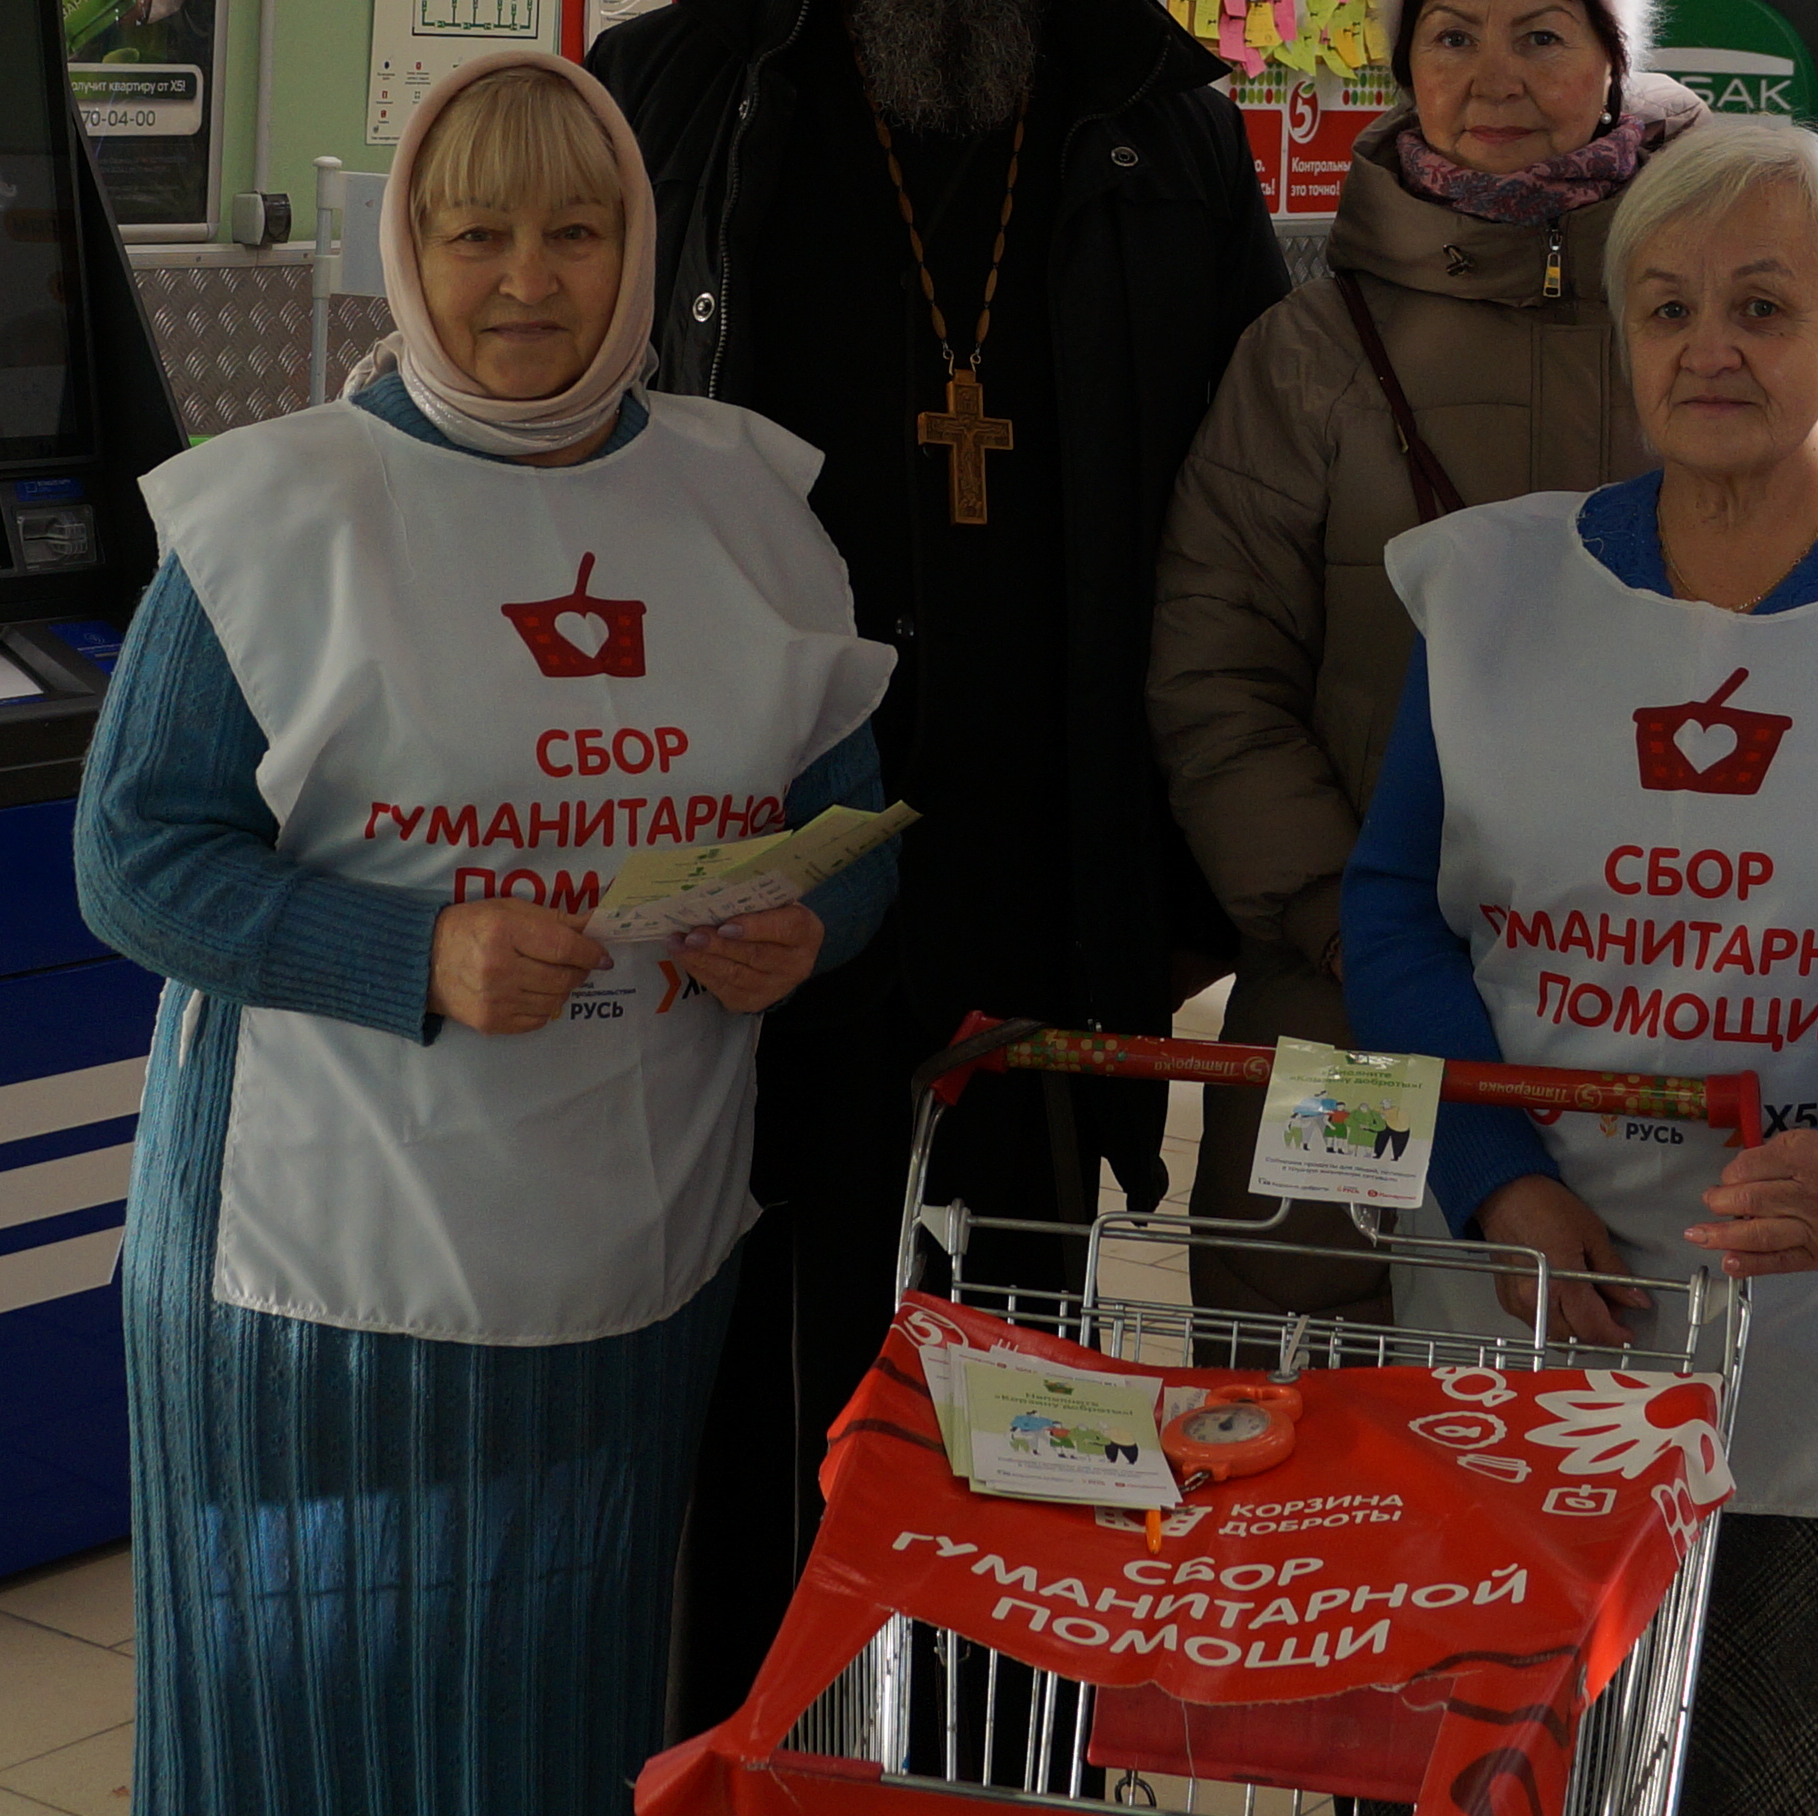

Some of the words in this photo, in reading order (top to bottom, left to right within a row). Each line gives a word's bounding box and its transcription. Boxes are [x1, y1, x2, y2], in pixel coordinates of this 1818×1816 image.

[71, 81, 107, 94] олучит
[109, 82, 156, 95] квартиру
[1680, 75, 1792, 110] БАК
[81, 110, 156, 126] 70-04-00
[1291, 157, 1352, 176] Контрольны
[1291, 184, 1307, 196] это
[1308, 180, 1340, 196] точно!
[536, 726, 689, 778] СБОР
[1604, 845, 1774, 902] СБОР
[570, 1001, 624, 1021] РУСЬ
[1626, 1122, 1683, 1144] РУСЬ
[1231, 1491, 1405, 1521] КОРЗИНА
[1218, 1509, 1403, 1537] ДОБРОТЫ
[892, 1530, 1529, 1631] ГУМАНИТАРНОЙ
[1123, 1556, 1324, 1592] СБОР
[992, 1596, 1392, 1671] ПОМОЩИ
